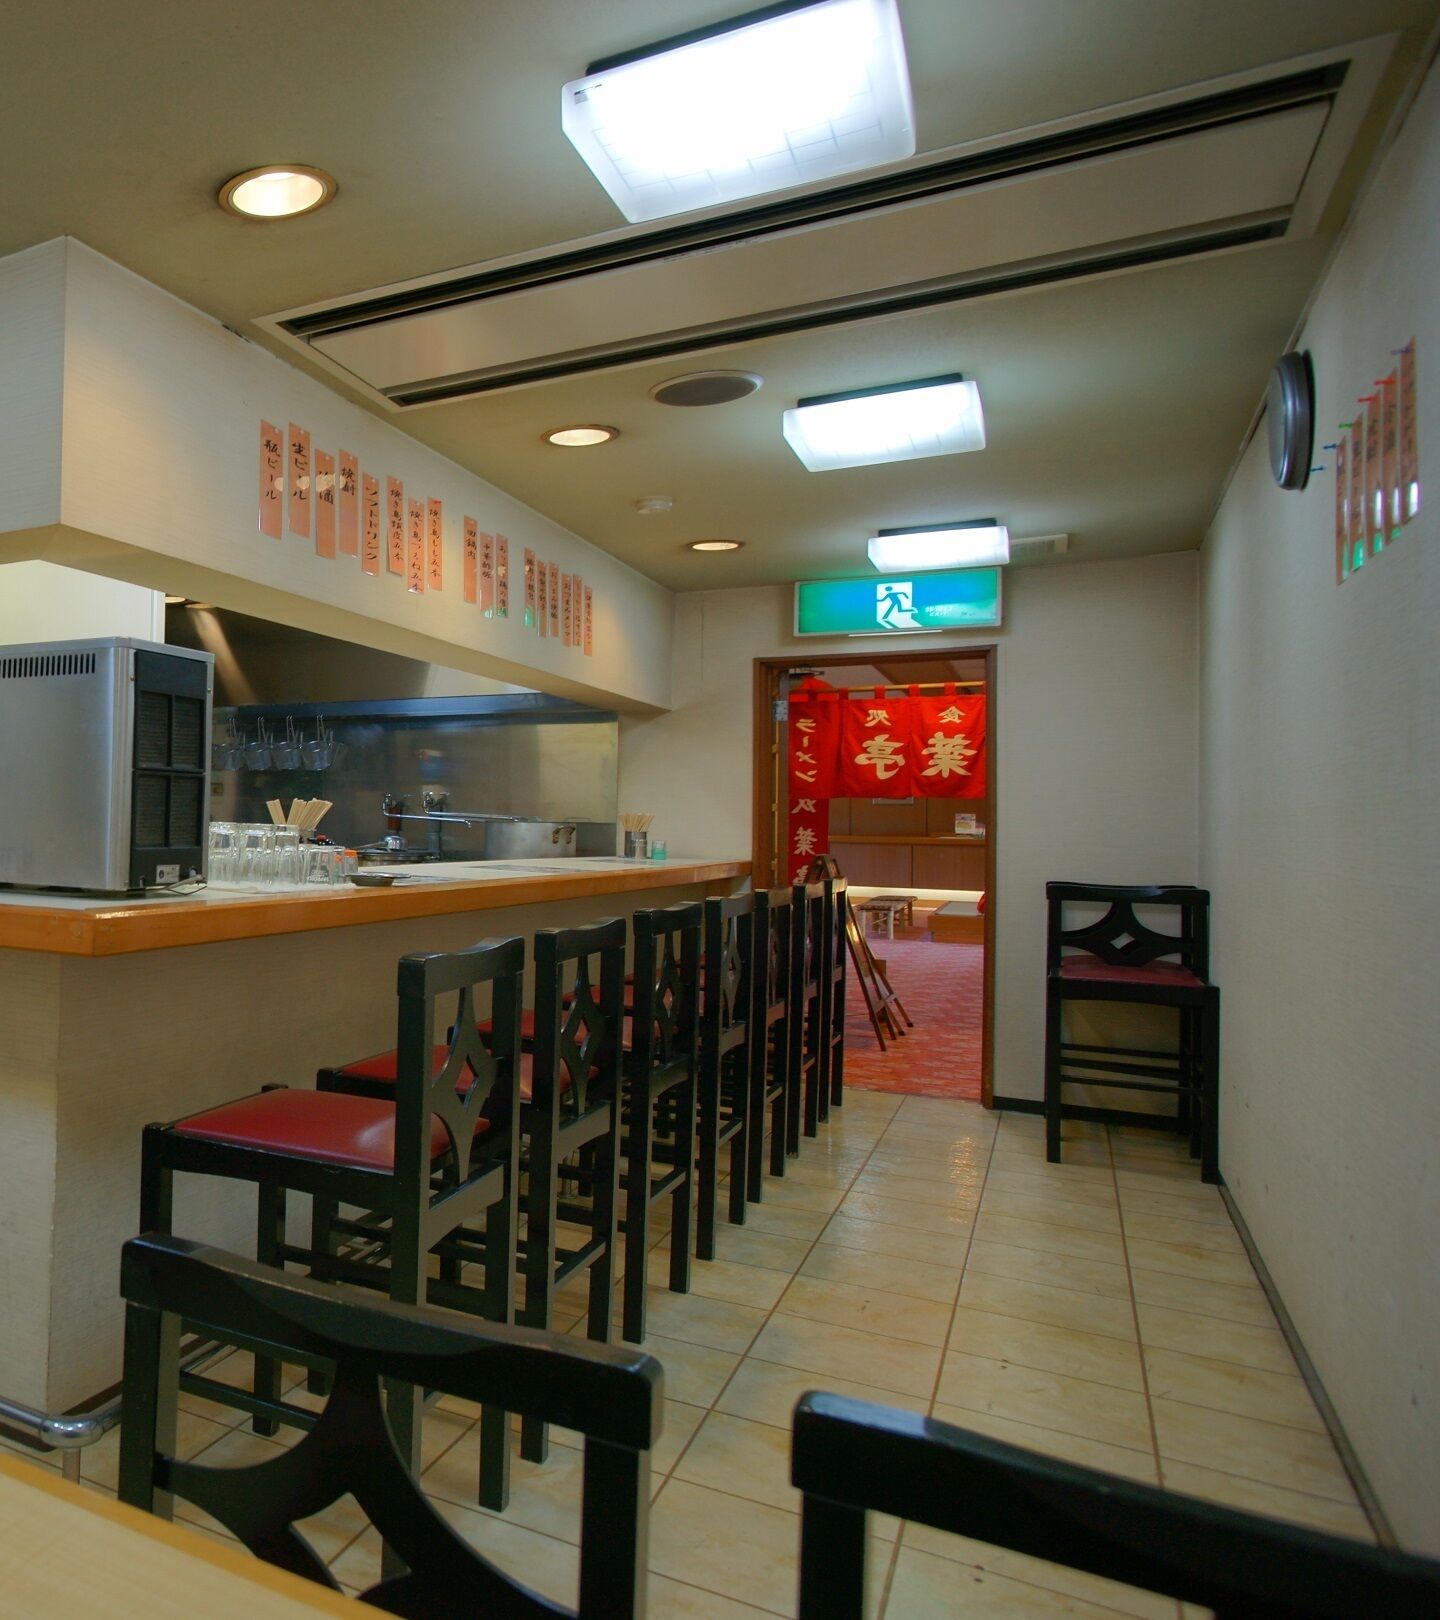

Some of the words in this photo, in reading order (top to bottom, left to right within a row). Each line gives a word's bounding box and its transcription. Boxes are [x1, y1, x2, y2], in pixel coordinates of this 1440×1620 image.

[264, 439, 281, 500] 瓶ビール
[291, 442, 308, 500] 生ビール
[318, 471, 334, 504] 酒
[365, 487, 378, 560] ソフトドリンク
